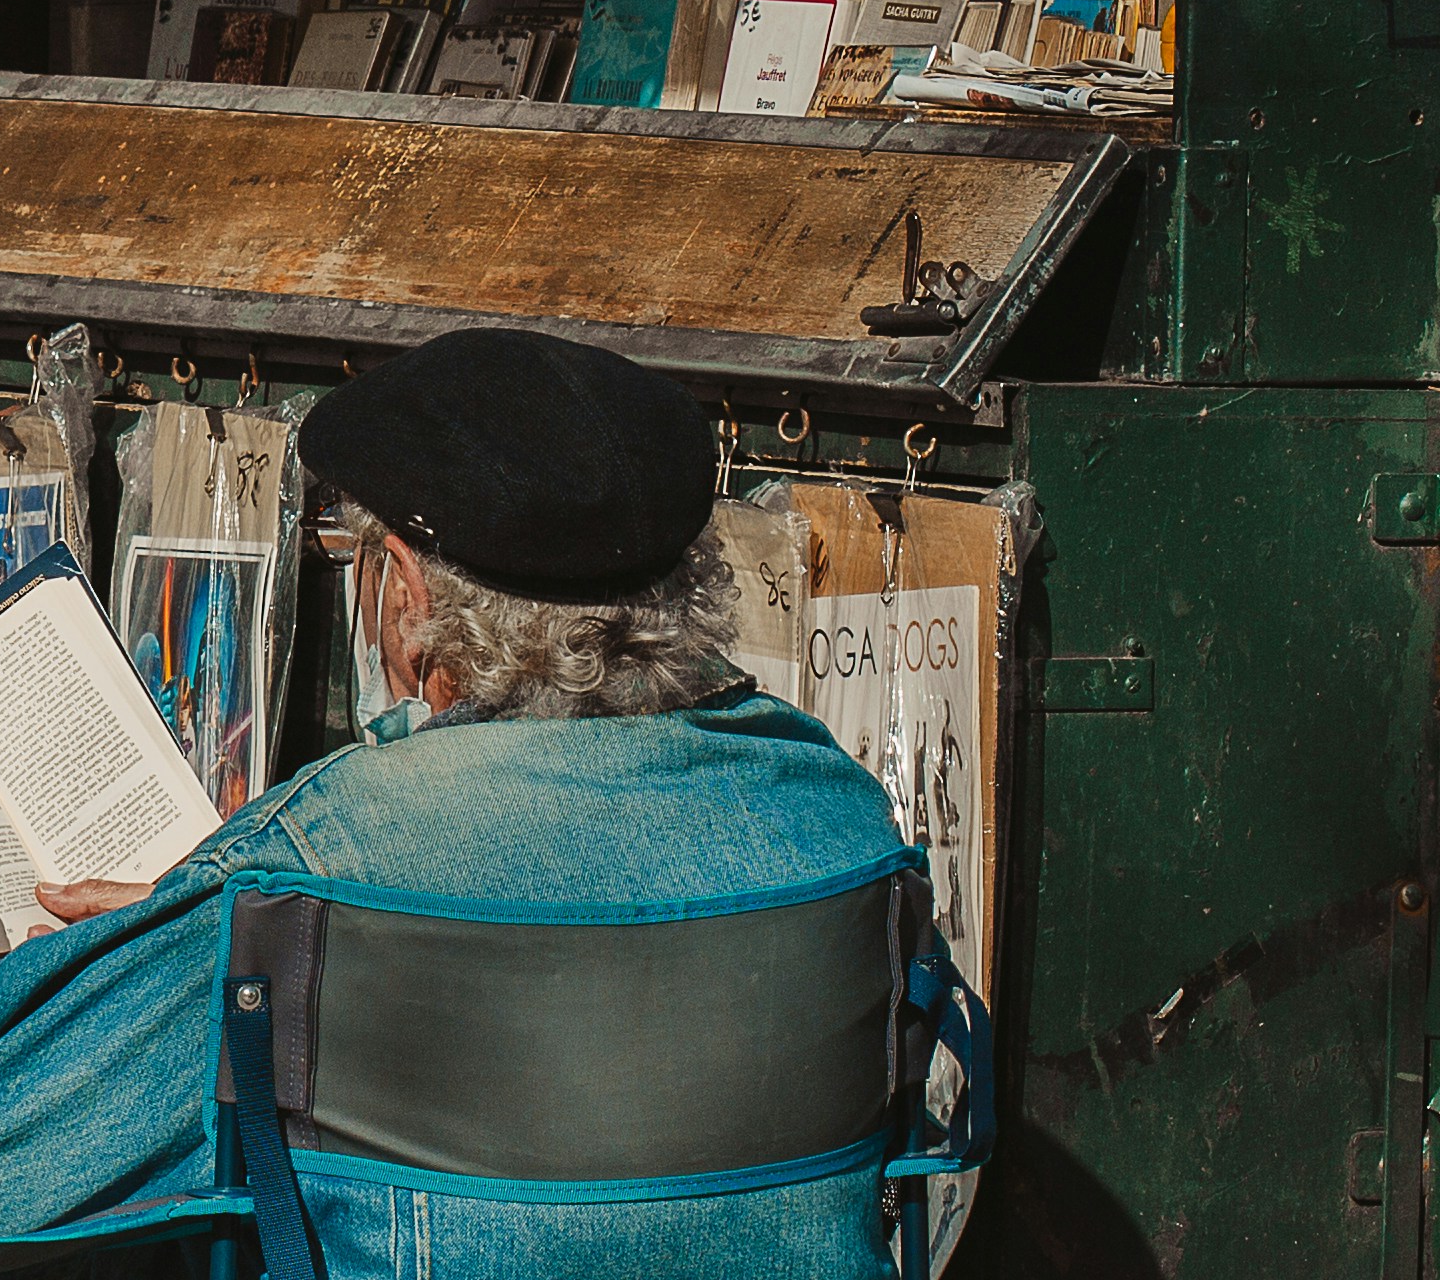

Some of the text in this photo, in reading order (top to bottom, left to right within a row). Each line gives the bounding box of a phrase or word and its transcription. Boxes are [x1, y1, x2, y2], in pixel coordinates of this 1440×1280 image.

[887, 5, 938, 20] SACHA GUITRY
[757, 69, 786, 82] Jauffret
[757, 98, 775, 109] Bravo
[809, 617, 959, 680] OGA DOGS
